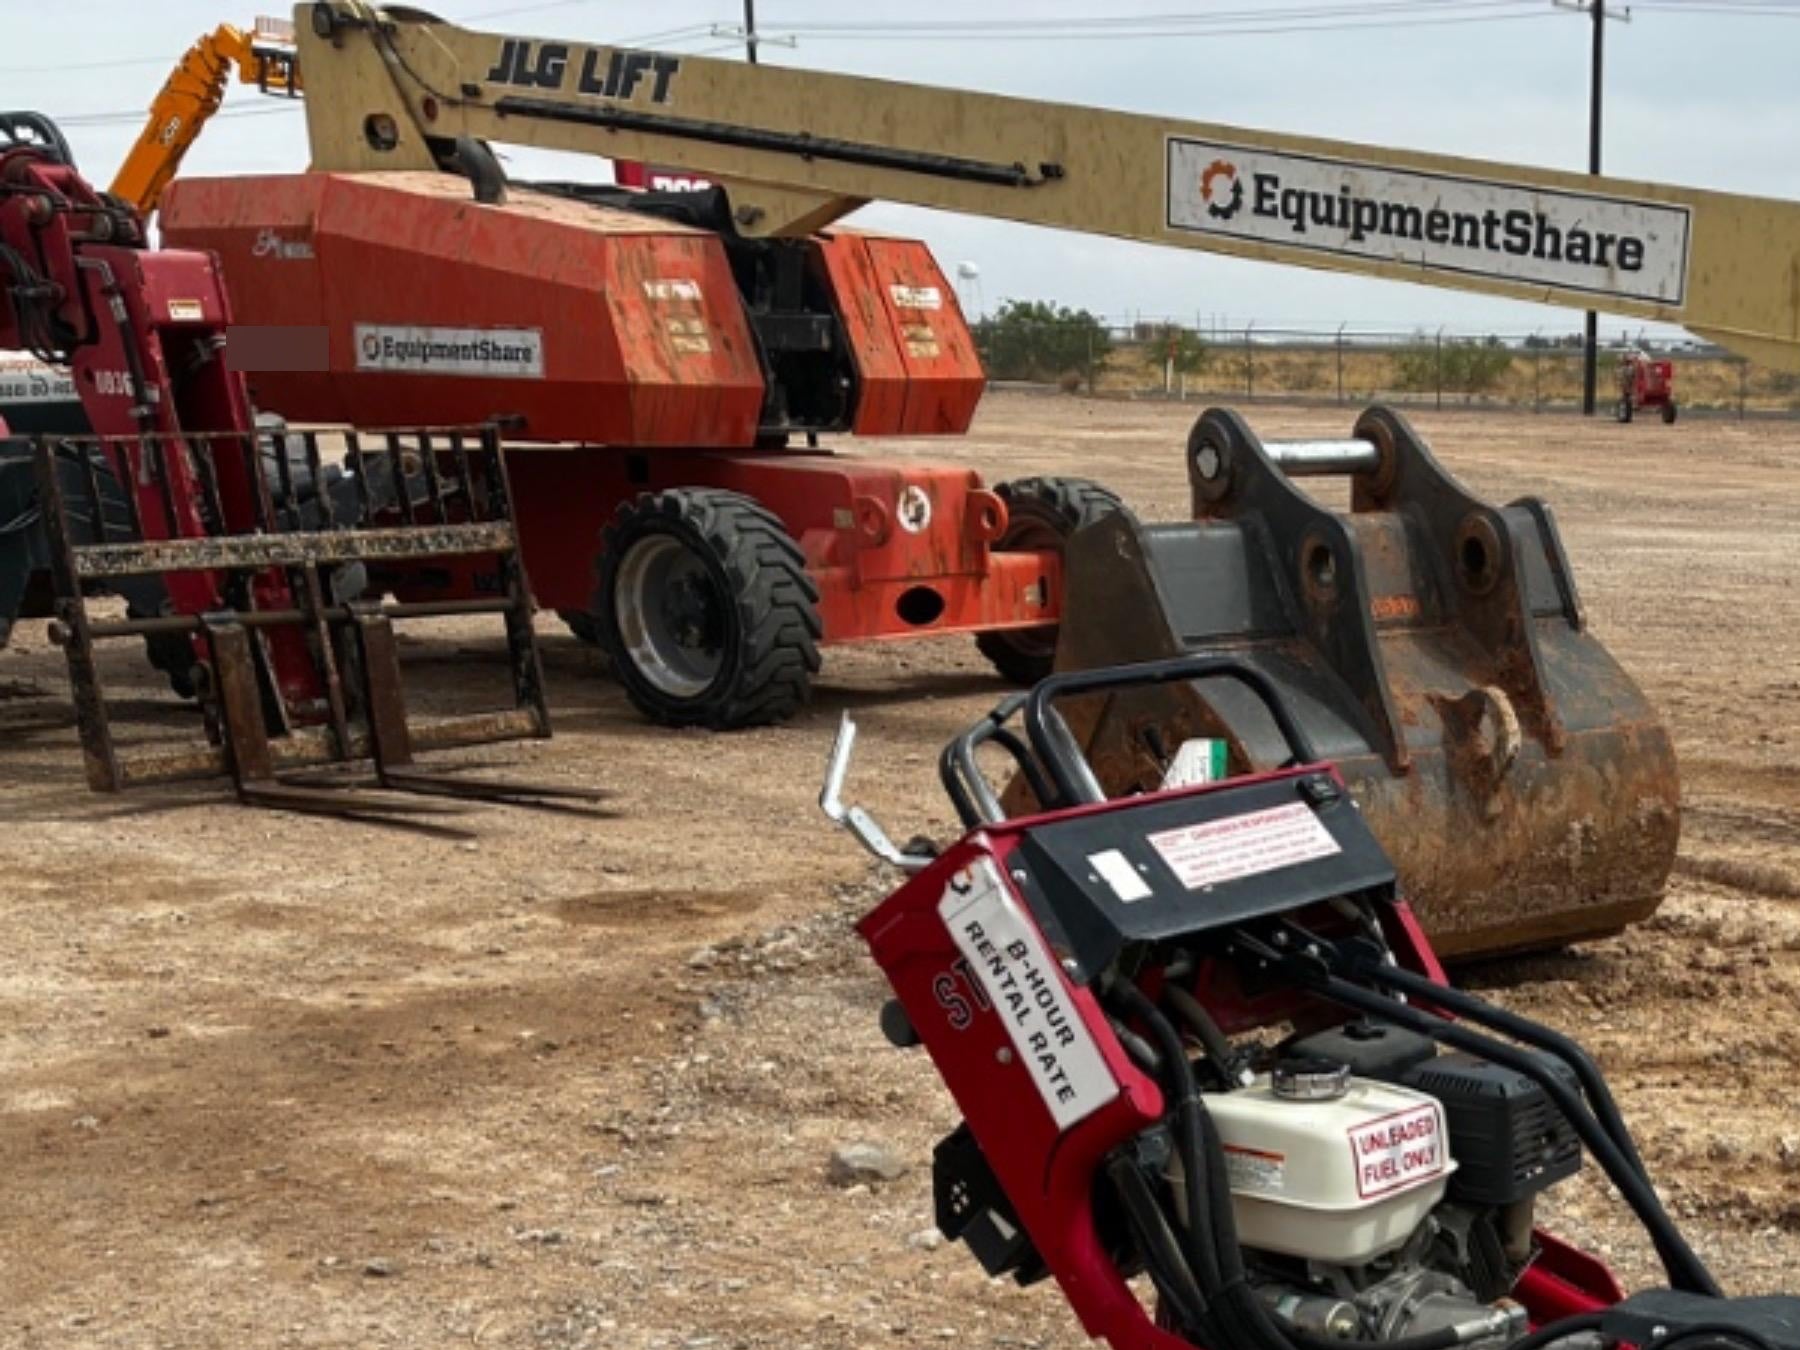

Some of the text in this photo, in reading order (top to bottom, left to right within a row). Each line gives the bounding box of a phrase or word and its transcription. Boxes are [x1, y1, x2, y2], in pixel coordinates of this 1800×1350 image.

[486, 40, 679, 103] JLG LIFT
[1253, 173, 1644, 271] EquipmentShare
[383, 336, 532, 363] EquipmentShare
[965, 920, 1078, 1105] RENTAL RATE
[1359, 1115, 1434, 1155] UNLEADED
[1364, 1144, 1436, 1184] FUEL ONLY
